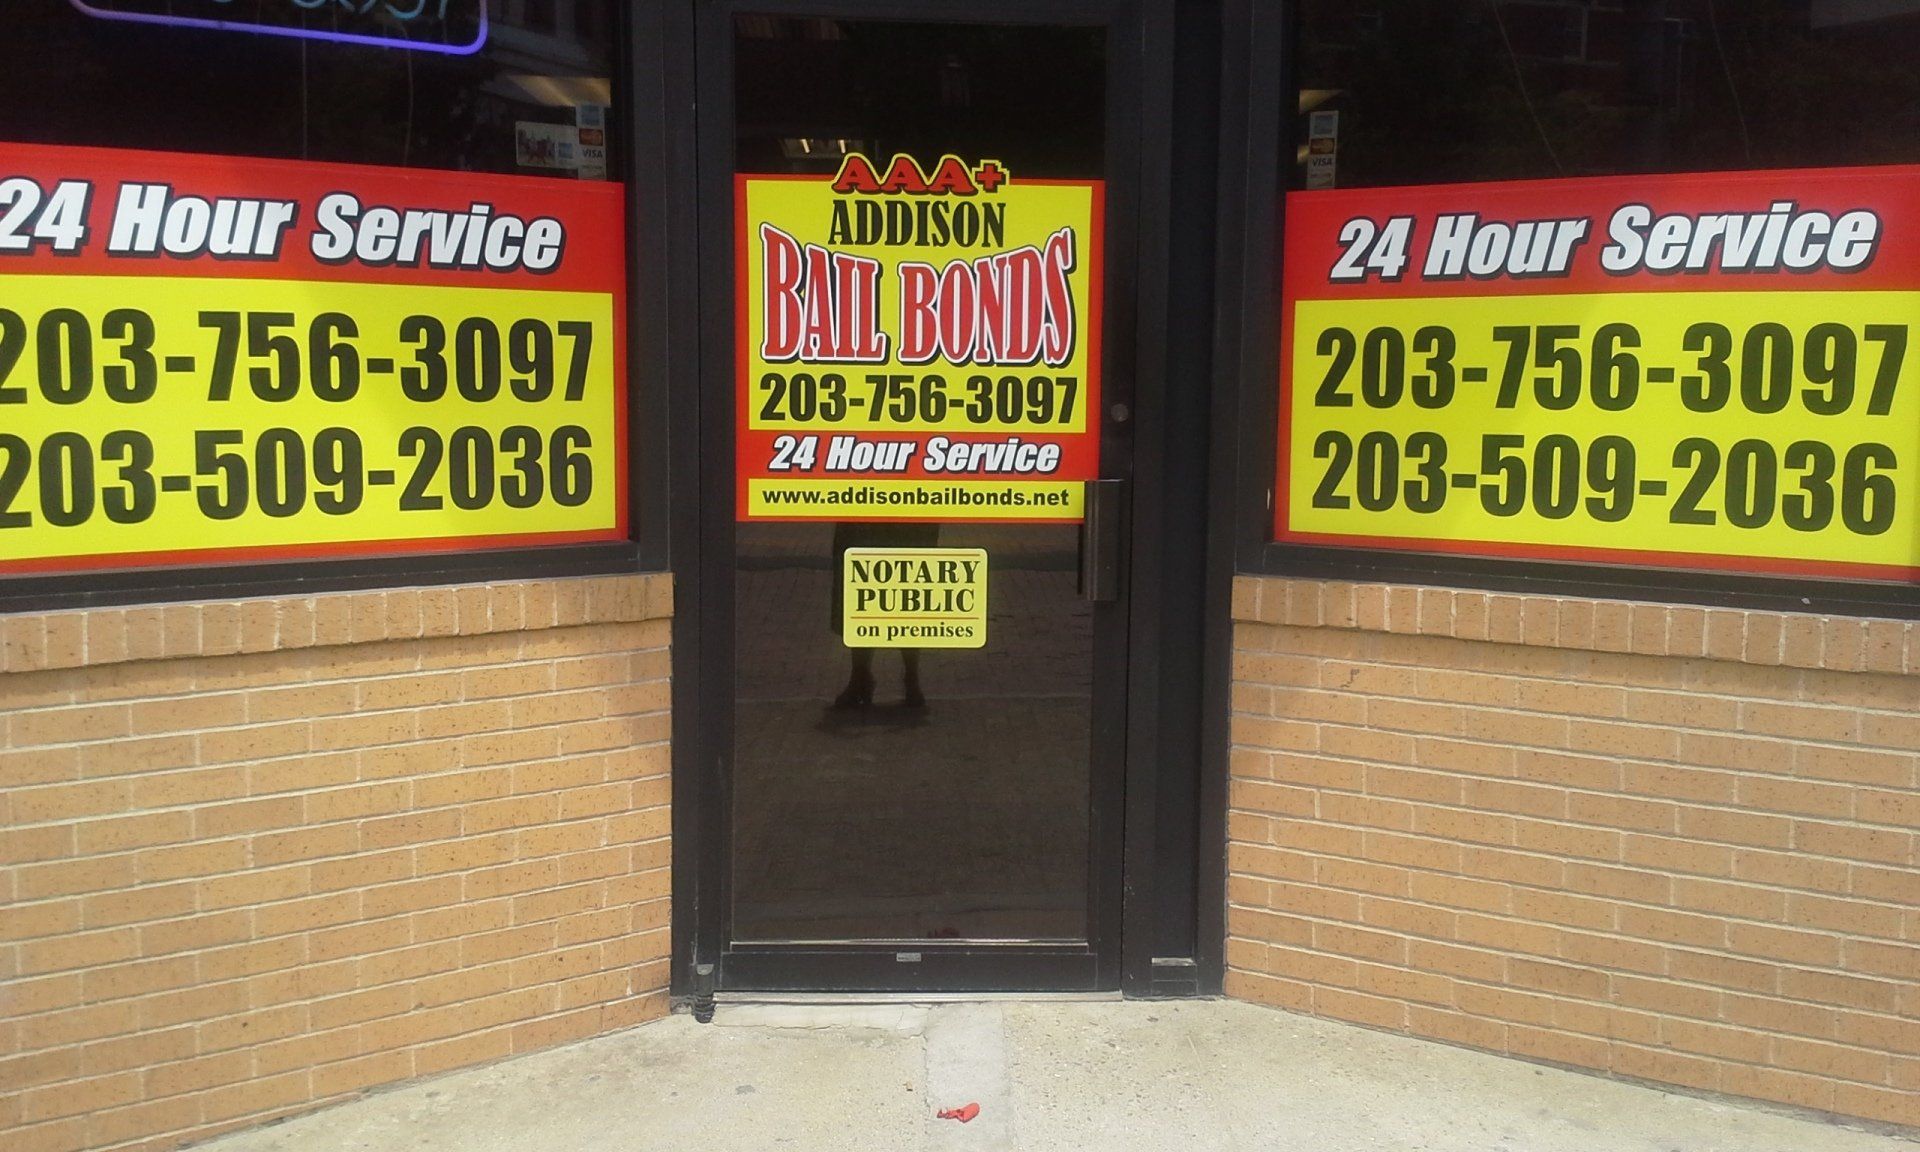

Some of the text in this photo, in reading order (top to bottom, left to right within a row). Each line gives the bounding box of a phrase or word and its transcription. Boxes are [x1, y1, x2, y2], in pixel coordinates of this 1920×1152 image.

[583, 149, 603, 158] VISA
[831, 153, 1009, 196] AAA+
[1312, 158, 1332, 167] VISA
[0, 177, 567, 272] 24 Hour Service
[827, 199, 1006, 249] ADDISON
[1329, 200, 1881, 282] 24 Hour Service
[760, 222, 1078, 369] BAIL BONDS
[1314, 321, 1910, 418] 203-756-3097
[760, 372, 1078, 425] 203-756-3097
[768, 435, 1062, 475] 24 Hour Service
[762, 485, 1070, 508] www.addisonbailbonds.net
[1311, 429, 1899, 537] 203-509-2036
[850, 559, 981, 584] NOTARY
[855, 588, 976, 613] PUBLIC
[856, 620, 975, 642] on premises
